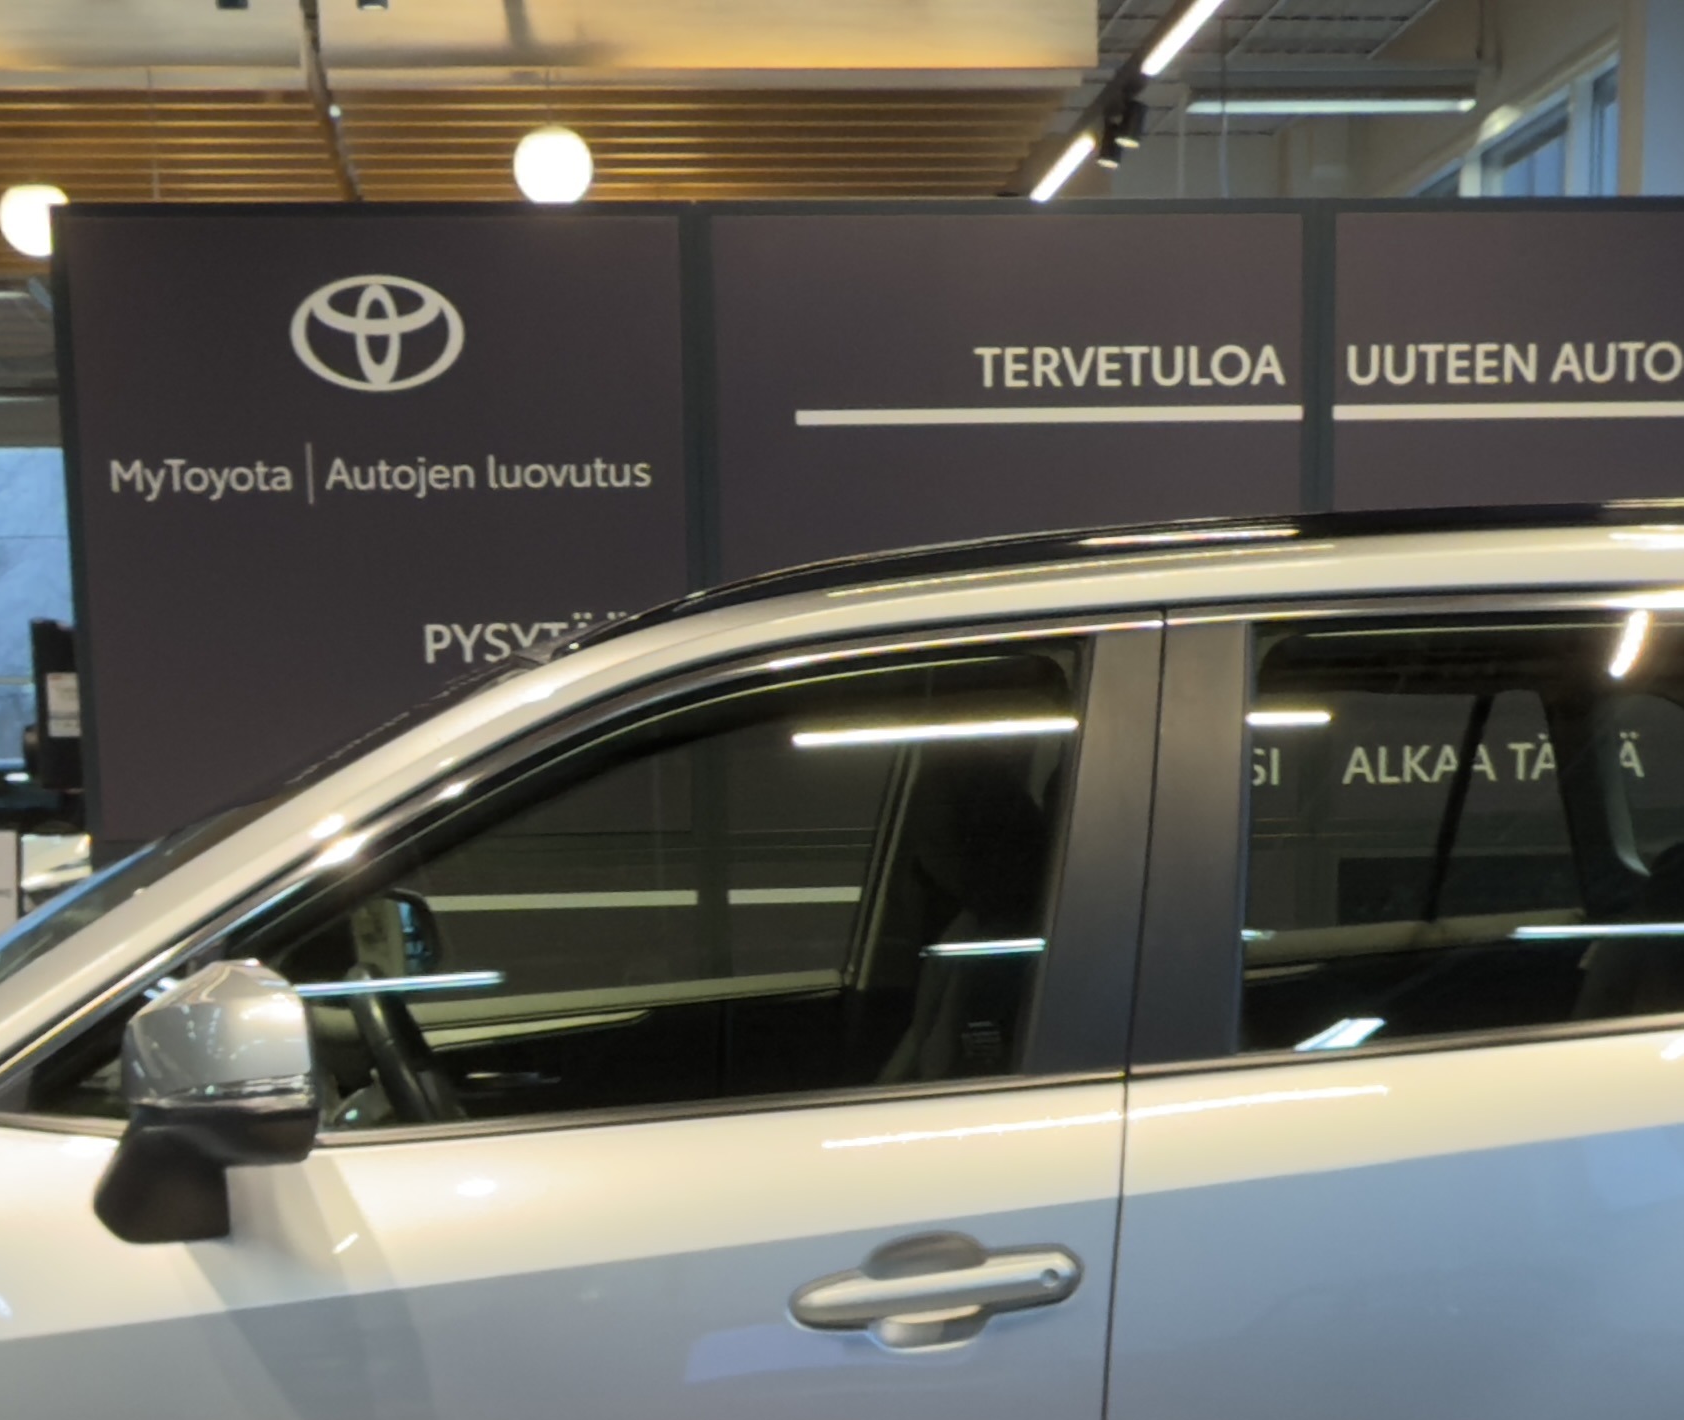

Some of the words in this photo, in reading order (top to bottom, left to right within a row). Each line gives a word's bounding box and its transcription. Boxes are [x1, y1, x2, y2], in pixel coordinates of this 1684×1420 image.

[974, 344, 1286, 388] TERVETULOA
[1346, 342, 1536, 386] UUTEEN
[110, 457, 294, 502] MyToyota
[324, 456, 476, 499] Autojen
[486, 453, 653, 489] luovutus
[1507, 731, 1645, 782] TÄÄ
